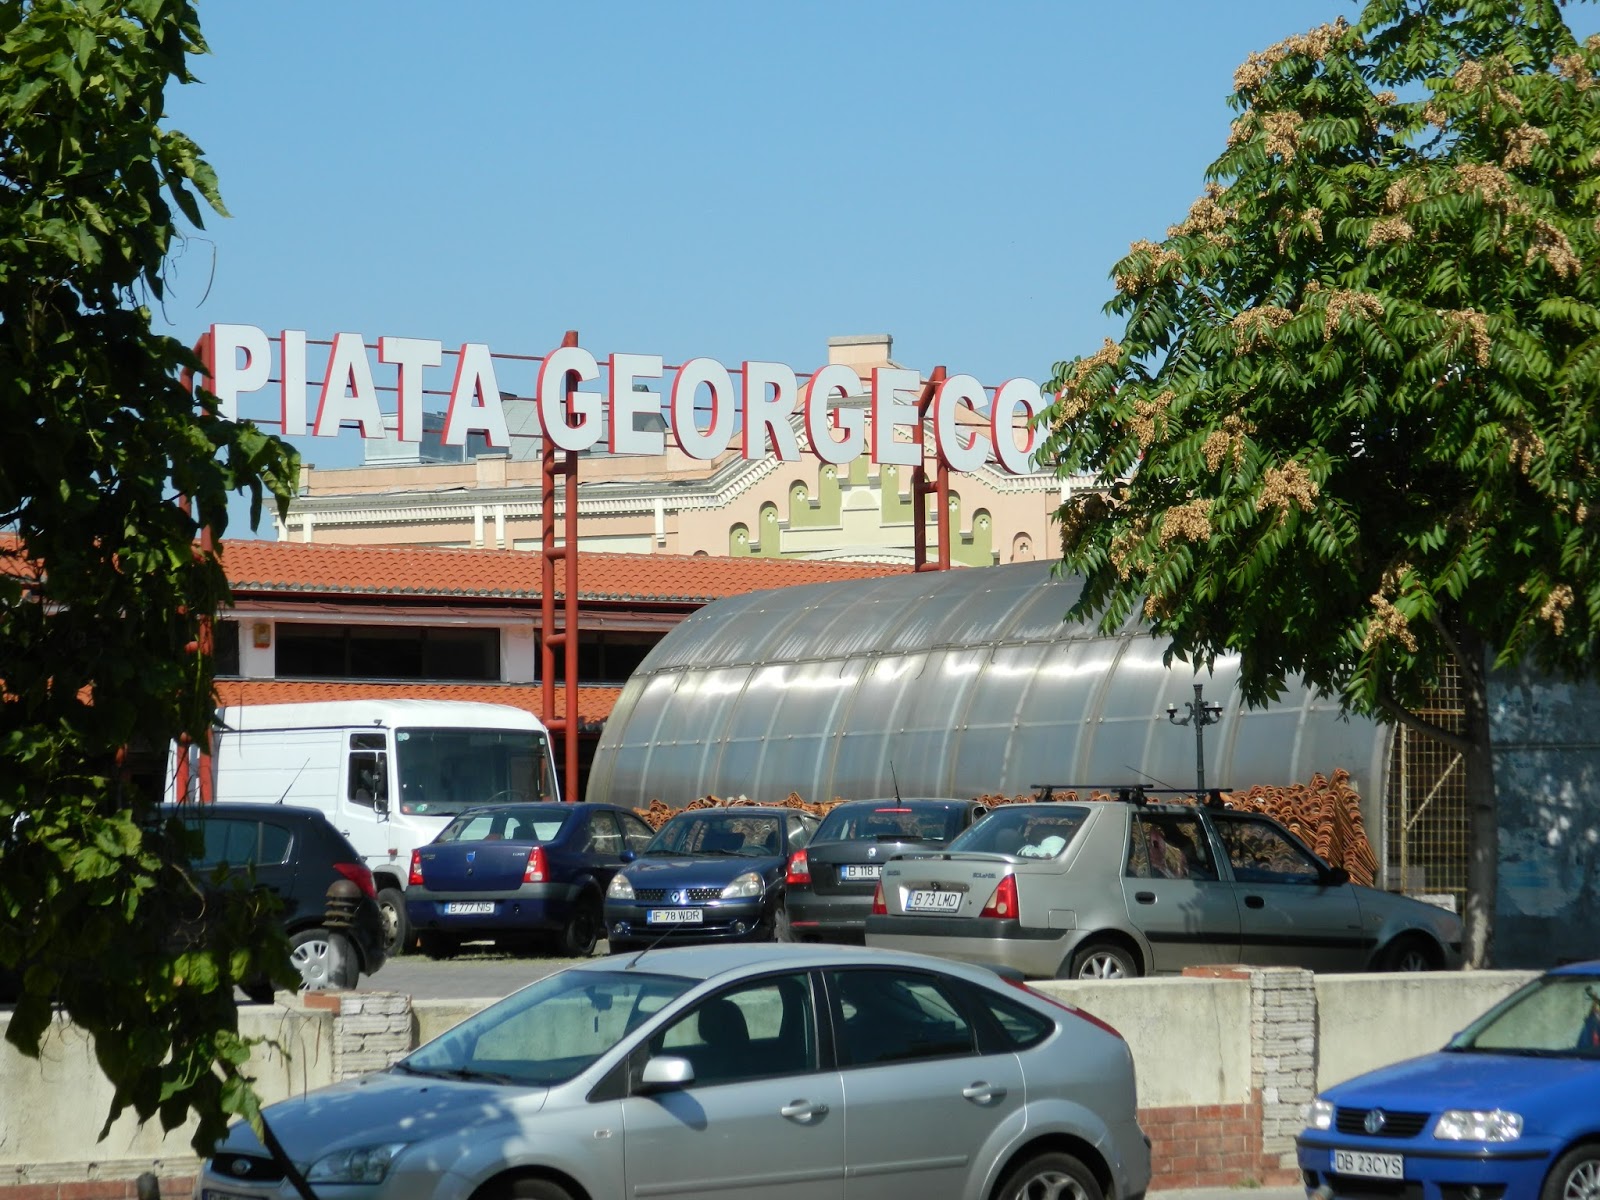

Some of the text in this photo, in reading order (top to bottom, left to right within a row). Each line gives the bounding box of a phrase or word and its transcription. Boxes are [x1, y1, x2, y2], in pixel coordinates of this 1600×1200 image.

[210, 323, 1062, 476] PIATA GEORGE CO
[849, 865, 856, 876] B
[860, 865, 873, 876] 118
[914, 893, 923, 906] B
[924, 893, 936, 906] 73
[450, 904, 457, 913] B
[459, 903, 475, 912] 777
[665, 911, 676, 920] 78
[1336, 1153, 1353, 1171] DB
